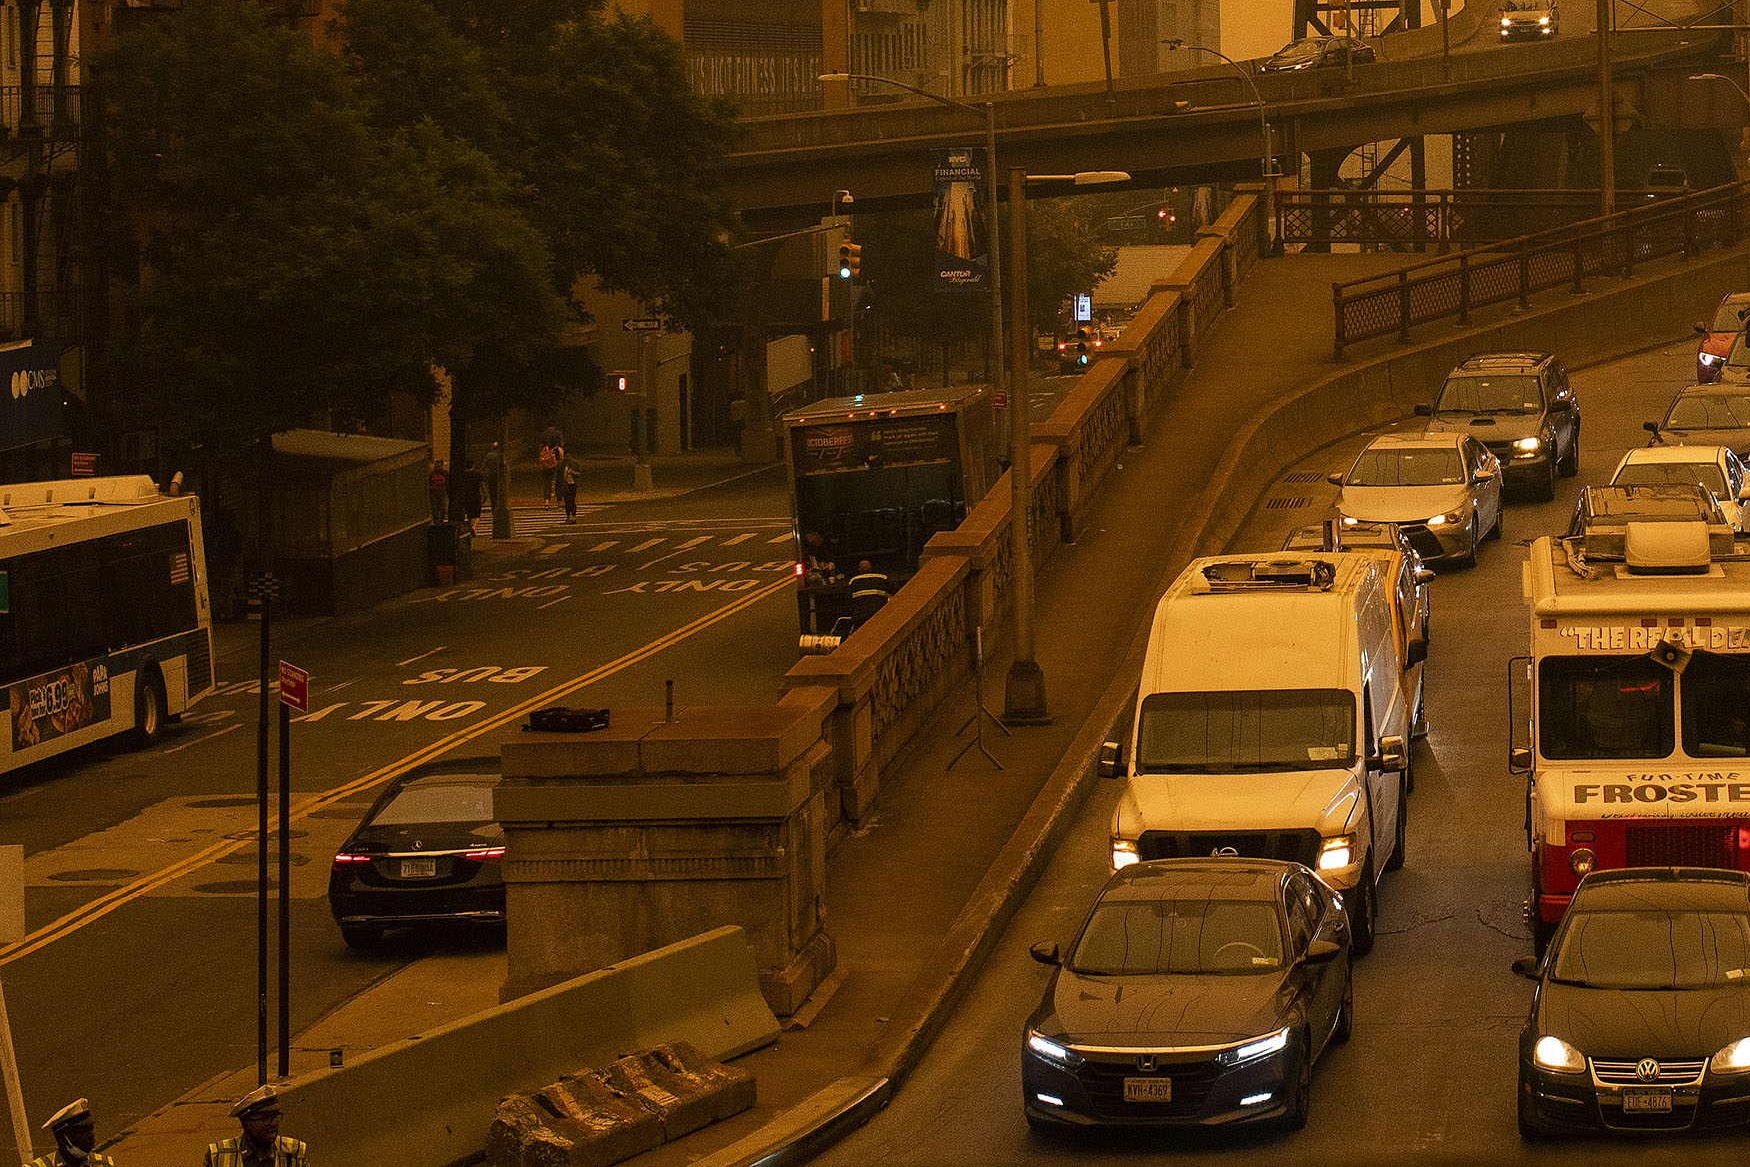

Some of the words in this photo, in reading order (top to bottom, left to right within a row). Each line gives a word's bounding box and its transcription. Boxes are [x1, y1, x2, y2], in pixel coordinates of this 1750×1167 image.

[603, 578, 760, 596] ONLY
[402, 666, 549, 684] BUS
[288, 700, 487, 724] ONLY
